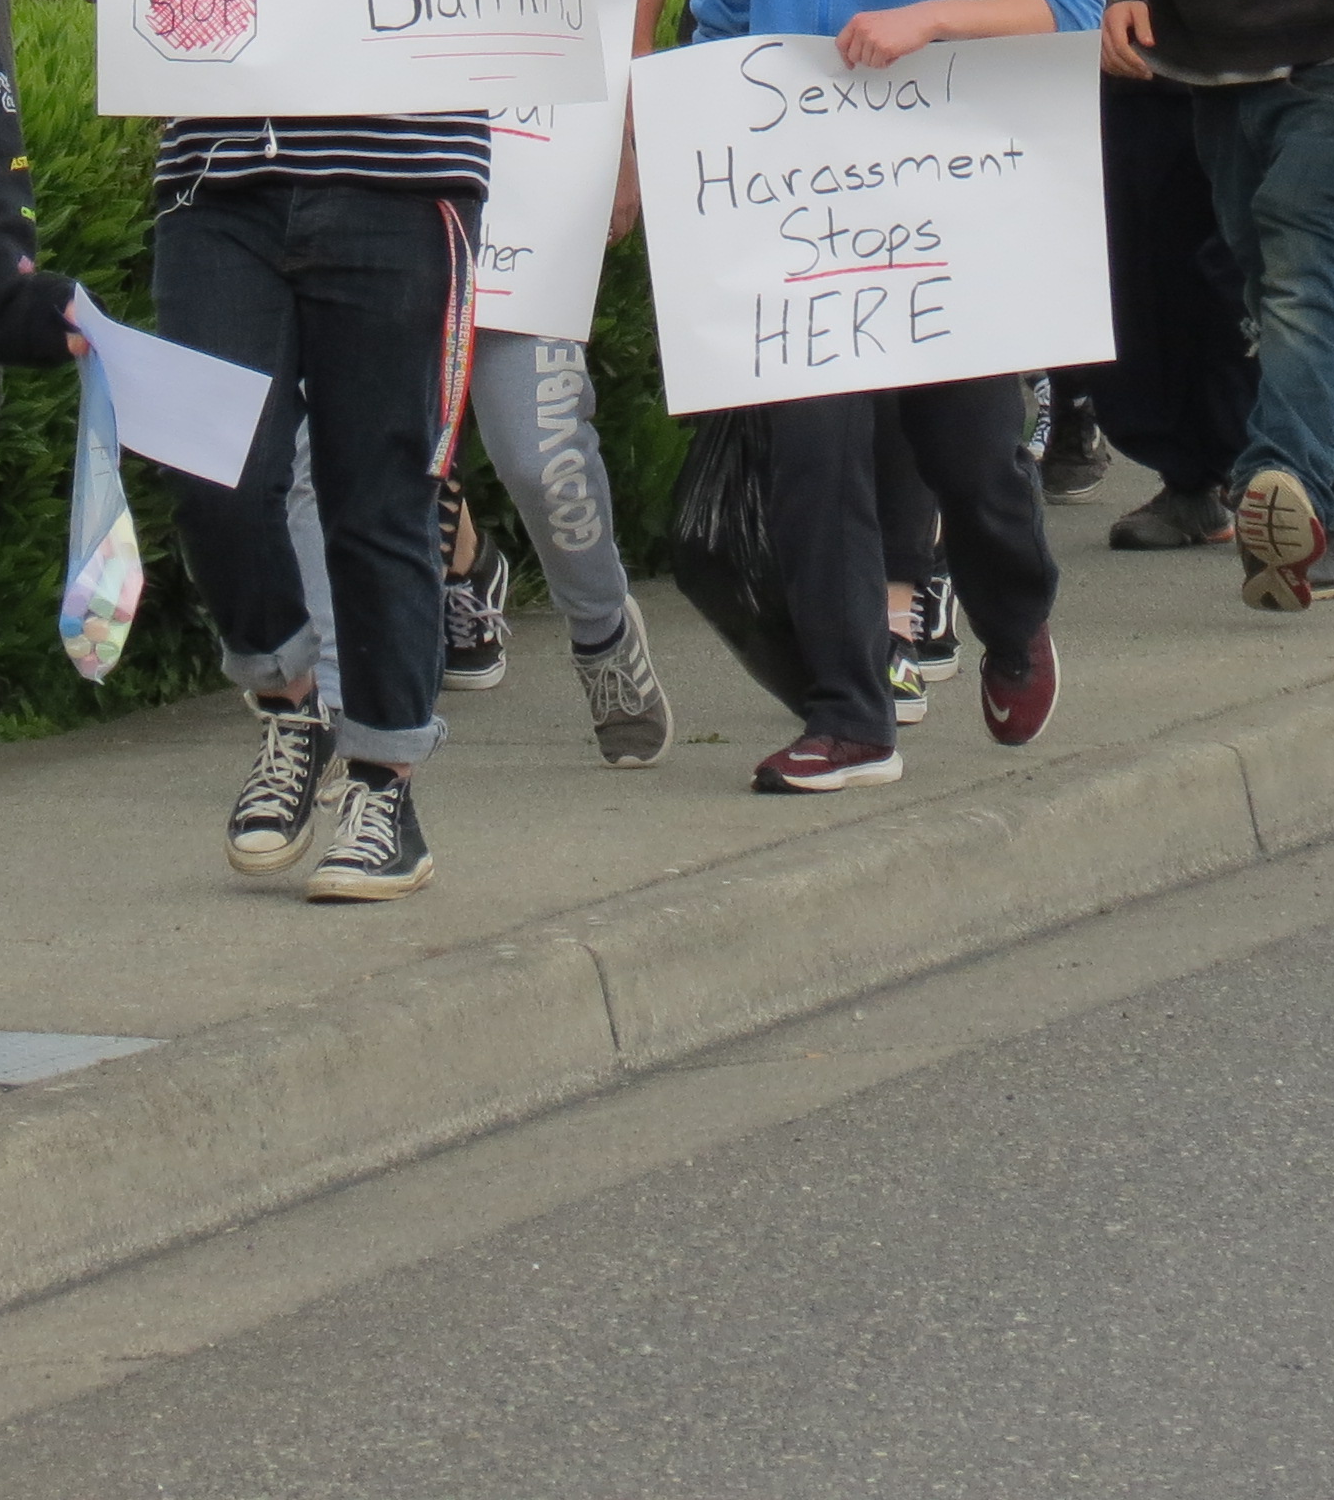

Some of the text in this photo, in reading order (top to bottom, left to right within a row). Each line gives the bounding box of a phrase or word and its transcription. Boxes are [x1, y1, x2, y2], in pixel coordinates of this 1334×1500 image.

[740, 41, 957, 133] Sexual
[695, 137, 1024, 216] Harassment
[779, 205, 942, 278] Stops
[753, 275, 953, 378] HERE
[535, 338, 603, 551] GOOD VIBE
